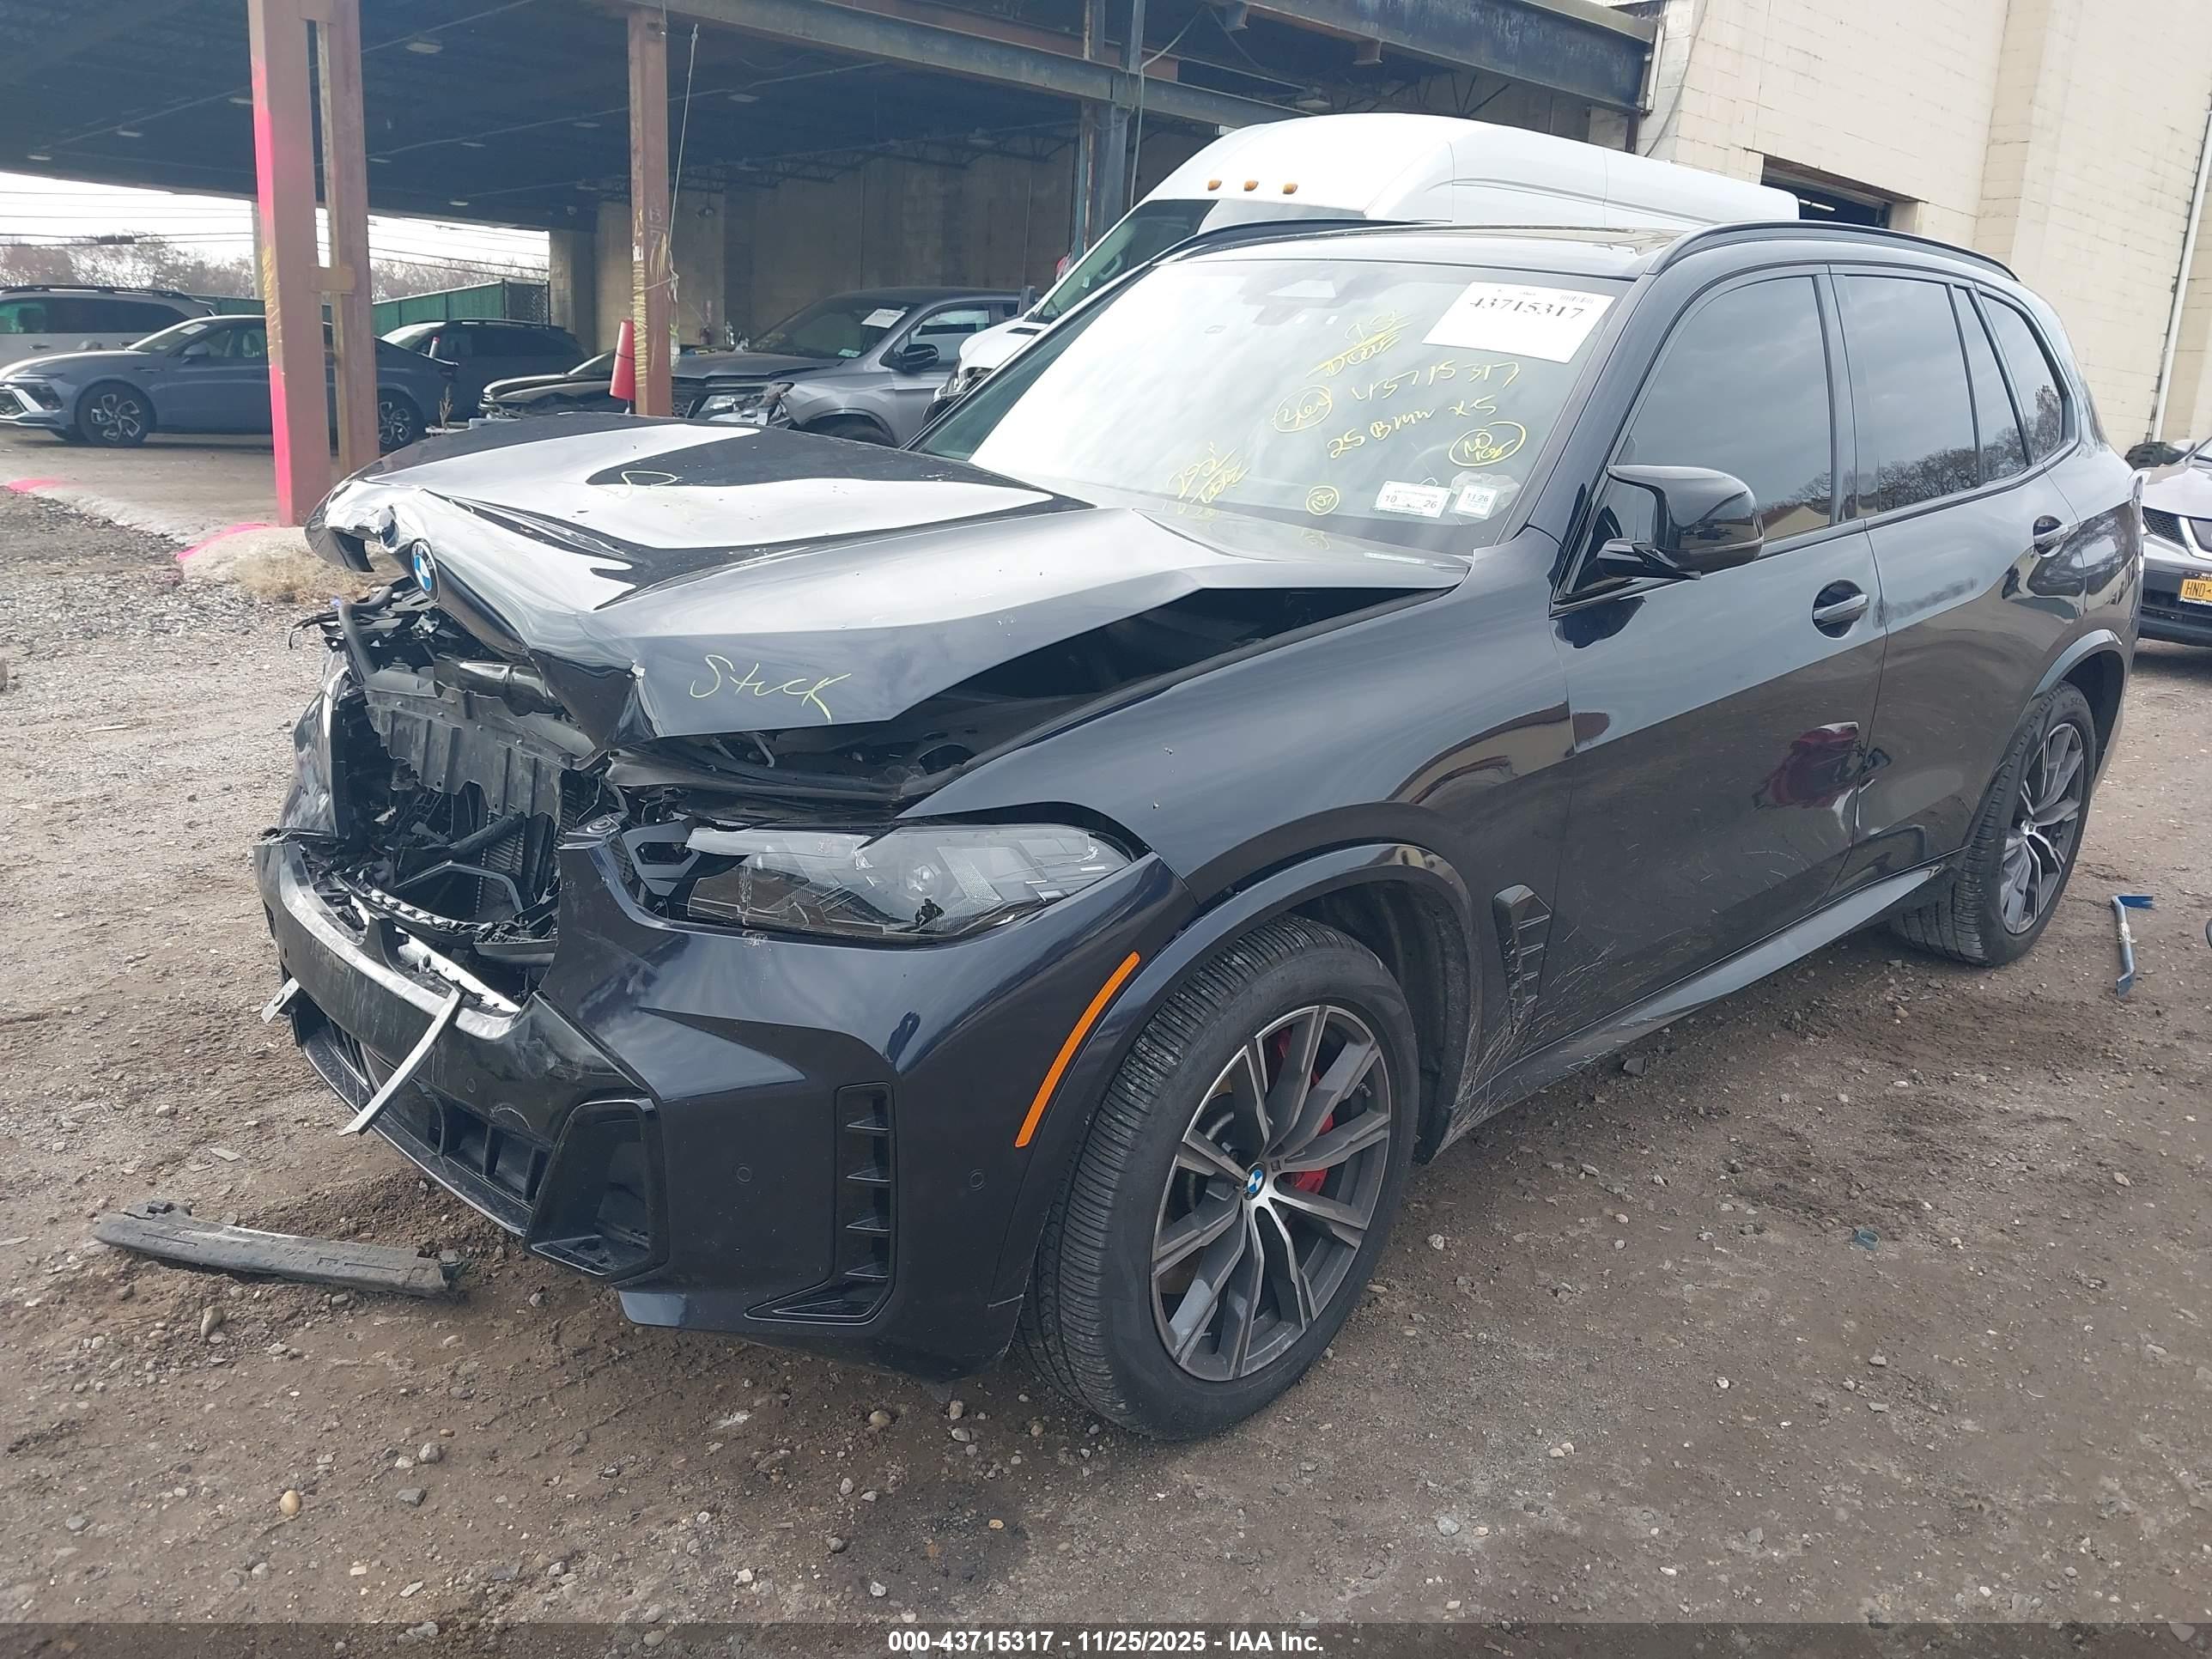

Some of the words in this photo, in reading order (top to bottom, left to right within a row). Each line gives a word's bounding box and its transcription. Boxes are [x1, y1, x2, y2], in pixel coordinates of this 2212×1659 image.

[1469, 296, 1586, 319] 43715317
[1327, 428, 1366, 459] 25
[1423, 500, 1438, 509] 26
